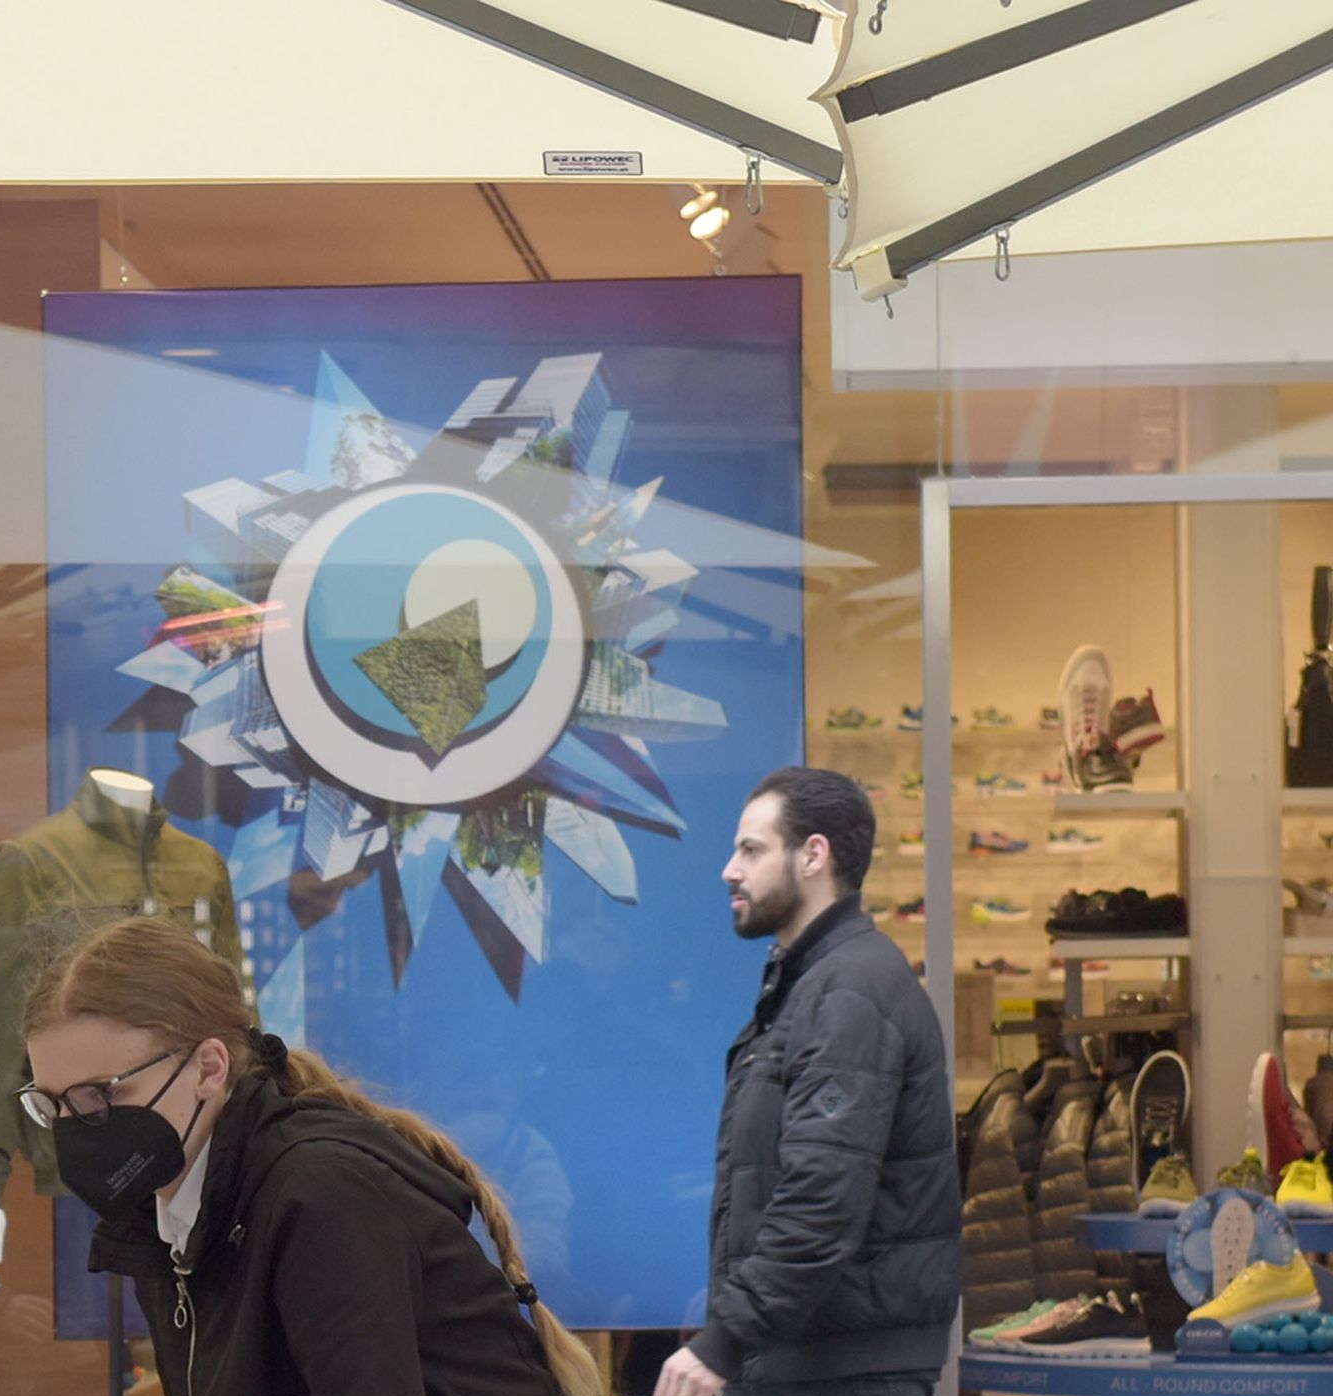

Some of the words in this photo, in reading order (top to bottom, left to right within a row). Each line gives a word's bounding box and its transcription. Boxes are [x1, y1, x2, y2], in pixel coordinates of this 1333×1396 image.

[1111, 1376, 1138, 1391] ALL
[1152, 1377, 1216, 1394] ROUND
[1219, 1378, 1309, 1395] COMFORT
